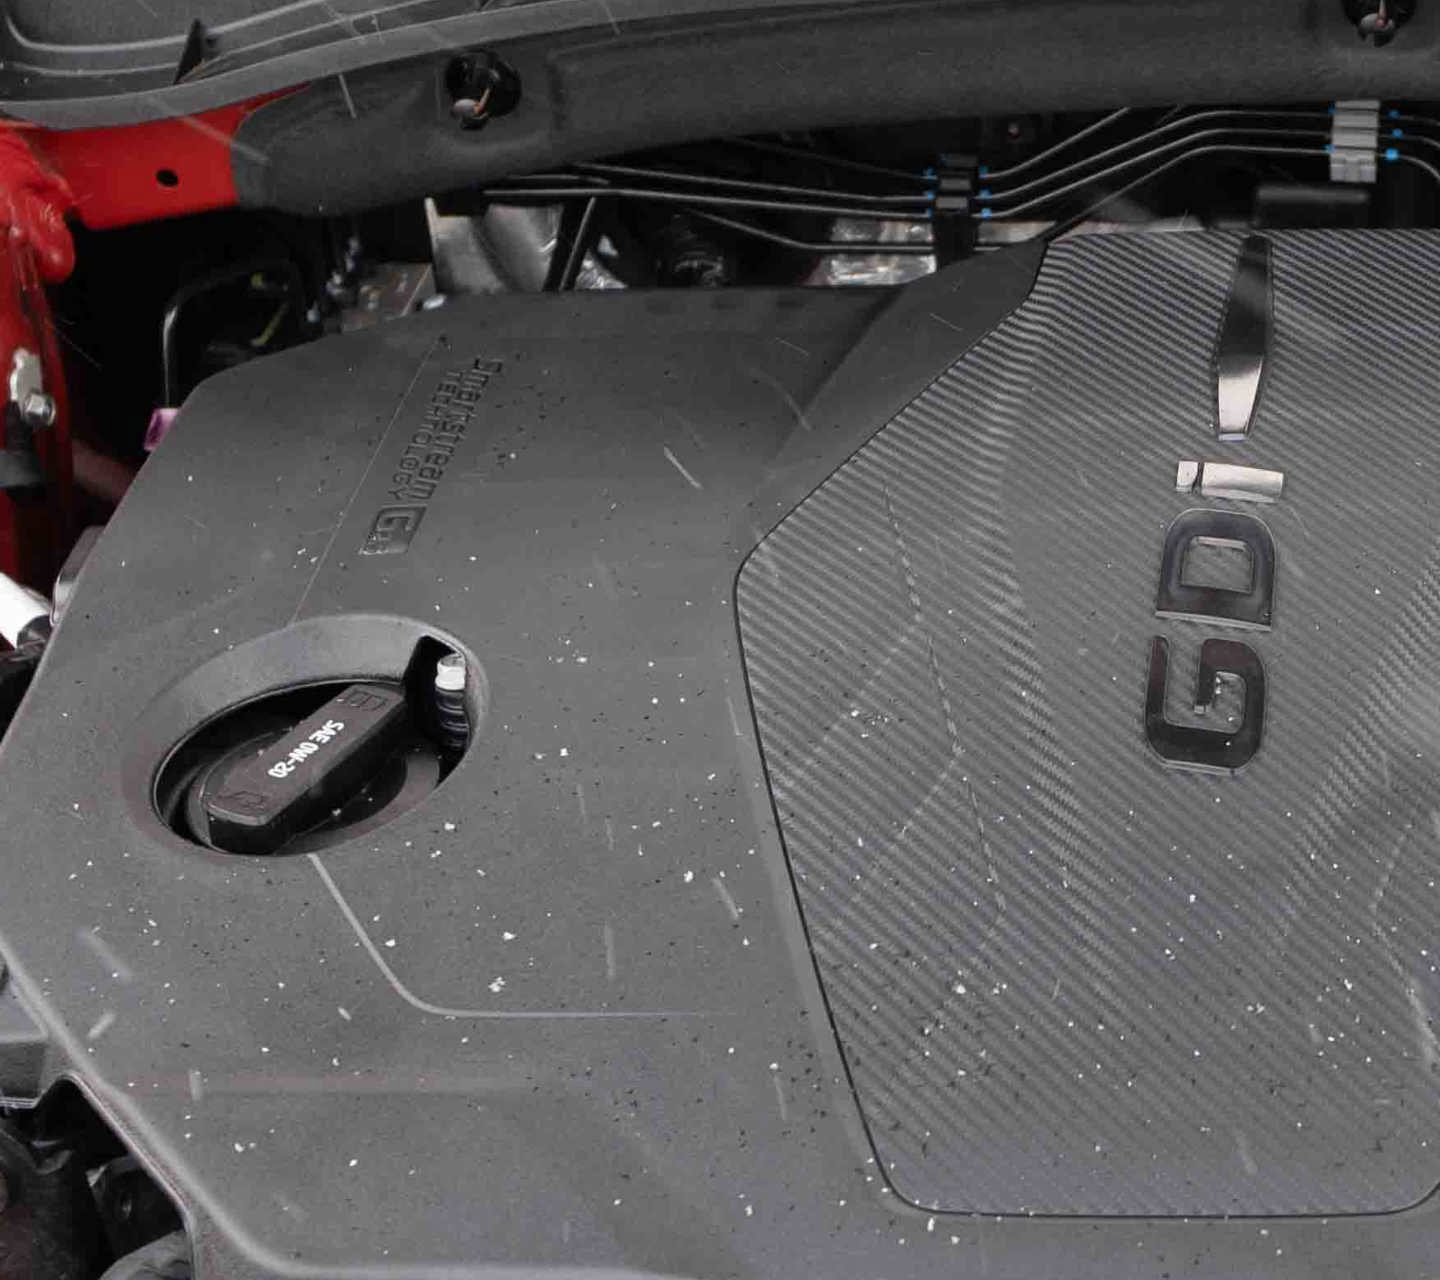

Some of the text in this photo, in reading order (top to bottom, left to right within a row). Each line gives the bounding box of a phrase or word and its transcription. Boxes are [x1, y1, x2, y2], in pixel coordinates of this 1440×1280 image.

[385, 370, 463, 502] TECHNOLOGY
[410, 357, 505, 501] Smartstream
[266, 719, 346, 780] SAE 0W-20
